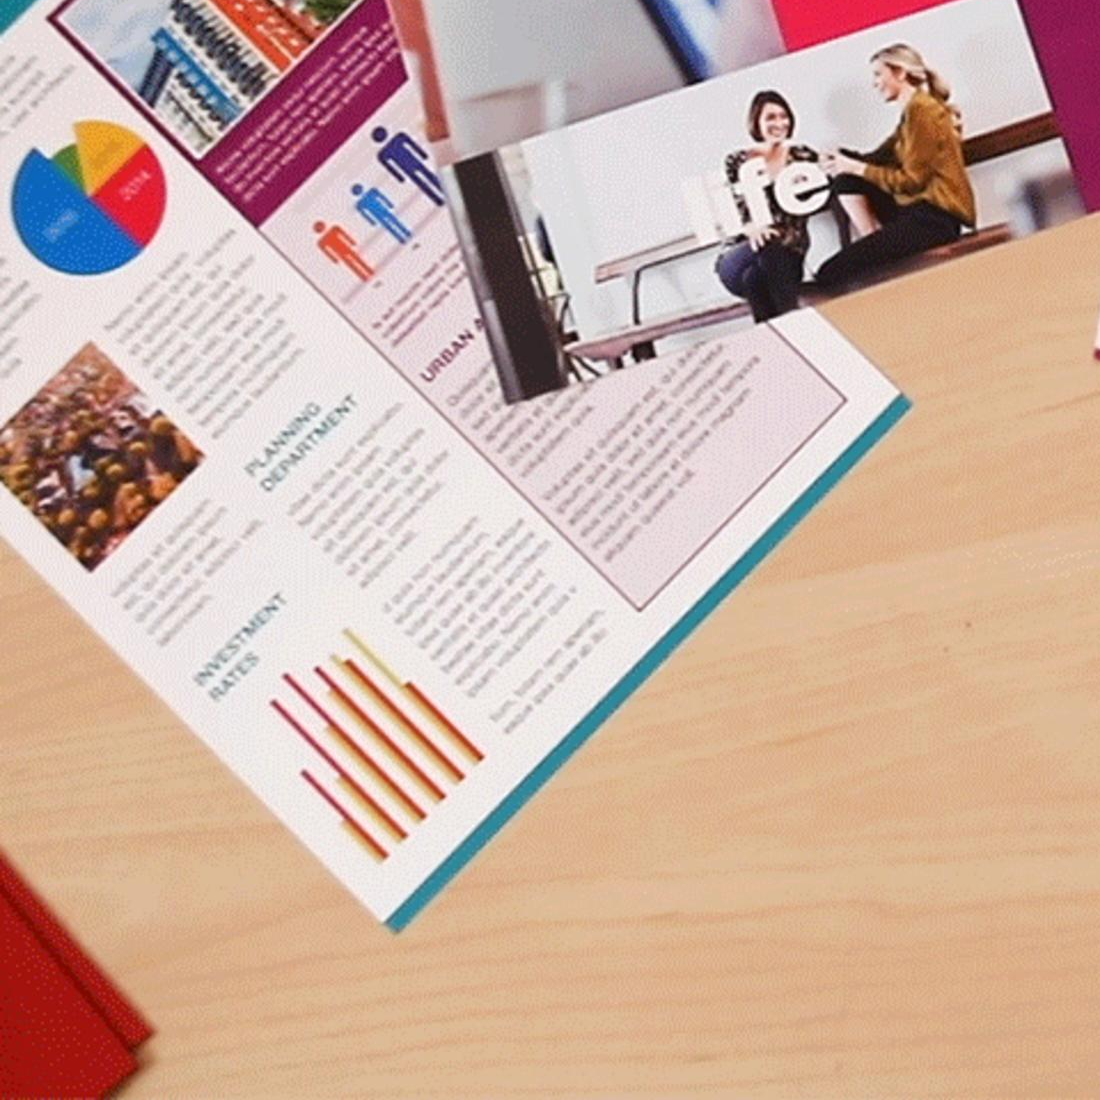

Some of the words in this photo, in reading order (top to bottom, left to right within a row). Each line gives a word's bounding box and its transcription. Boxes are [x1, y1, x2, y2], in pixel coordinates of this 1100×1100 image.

[418, 326, 475, 385] URBAN
[242, 399, 324, 479] PLANNING
[256, 392, 361, 494] DEPARTMENT
[192, 589, 288, 688] INVESTMENT
[207, 648, 261, 703] RATES
